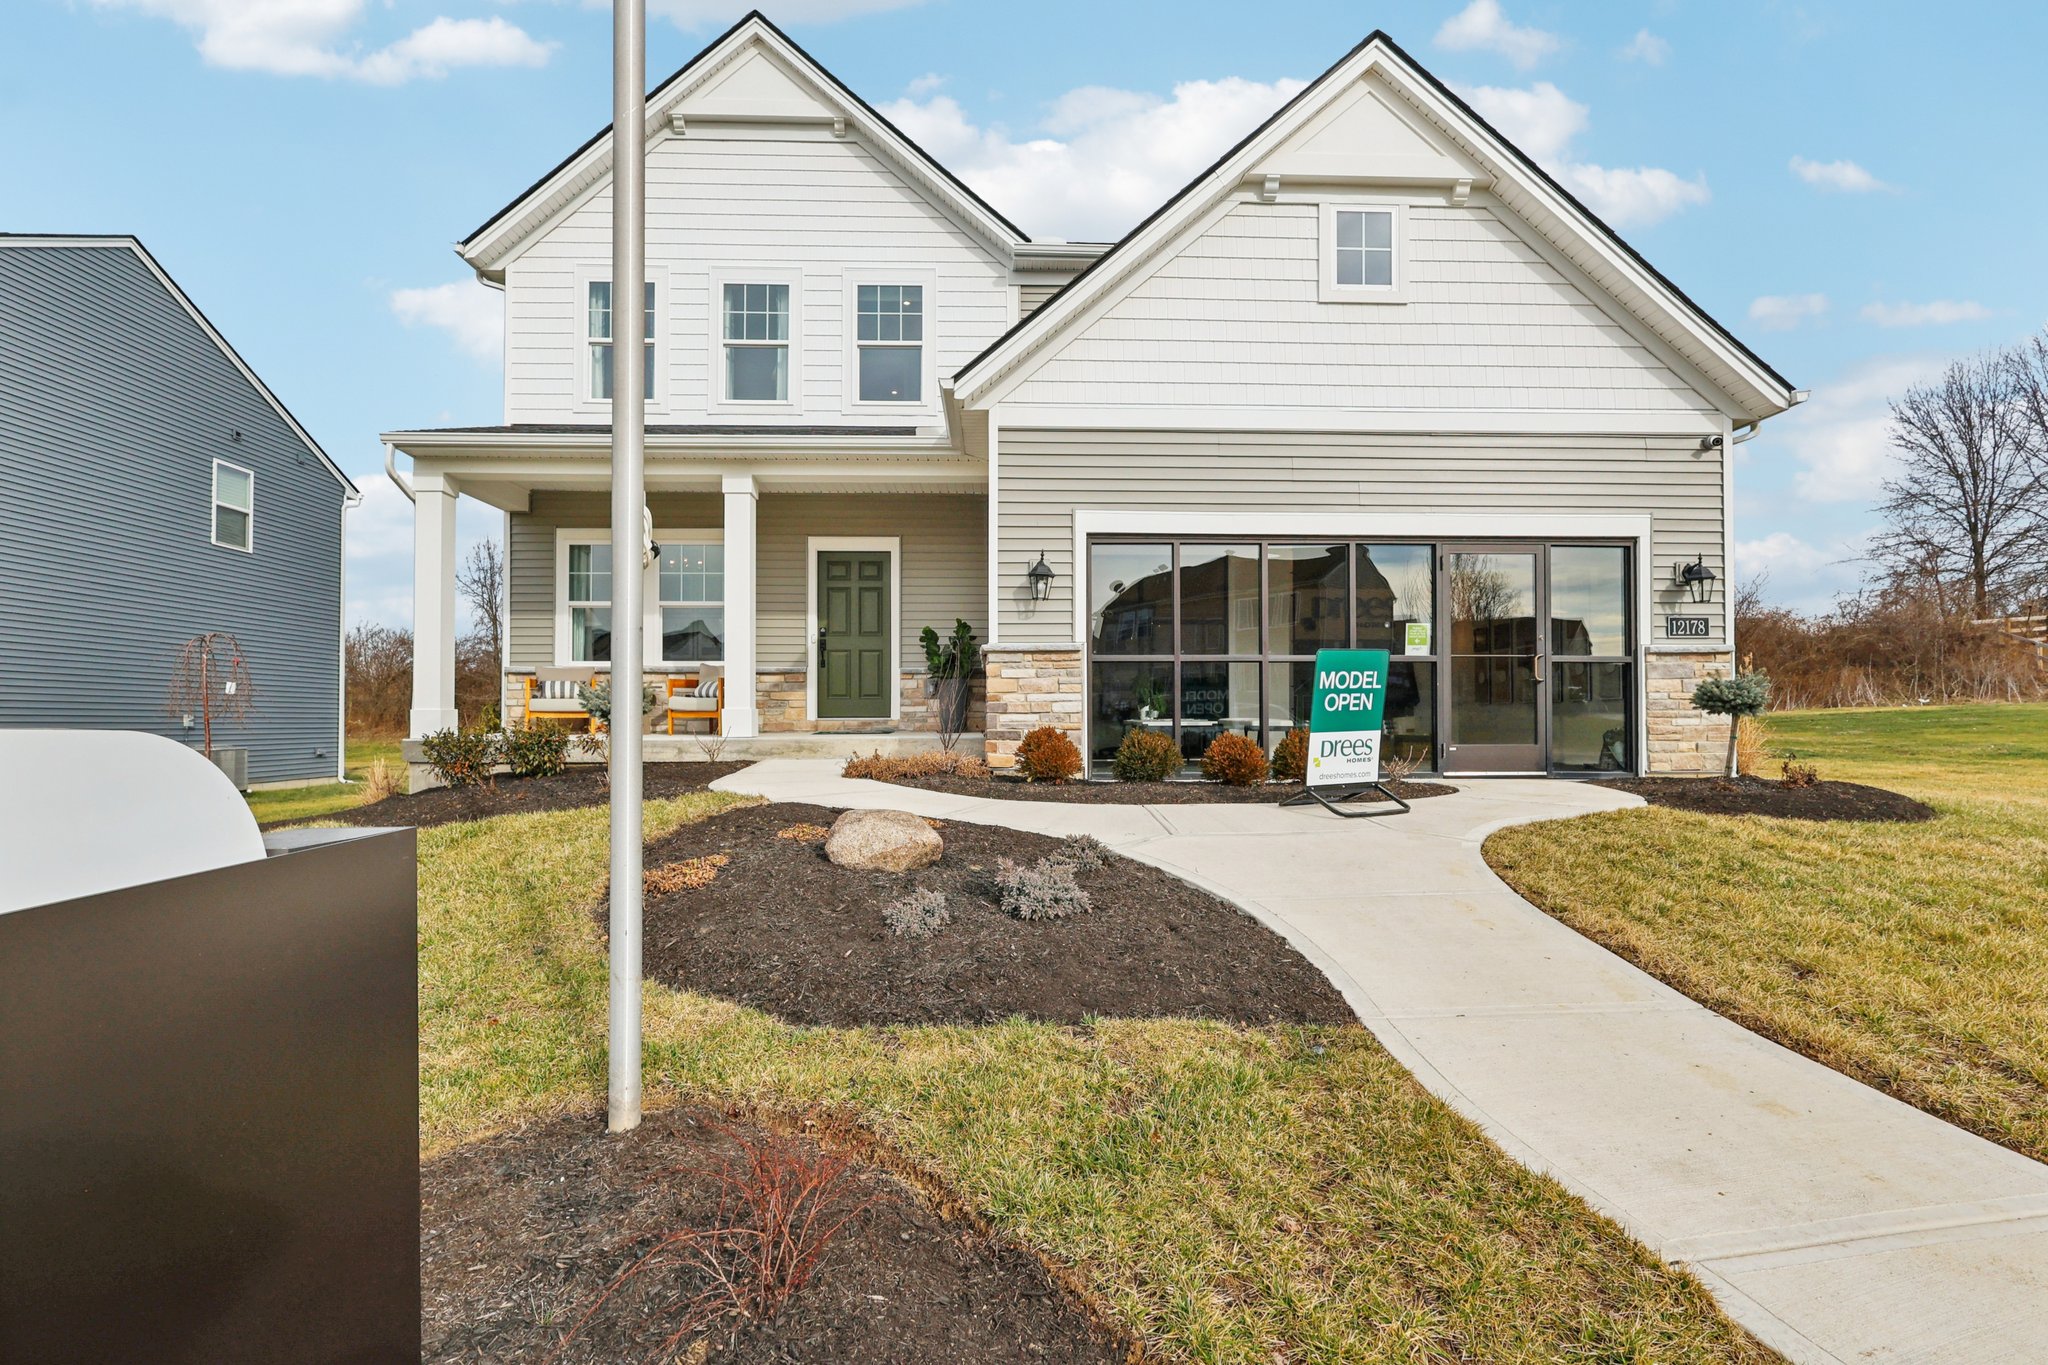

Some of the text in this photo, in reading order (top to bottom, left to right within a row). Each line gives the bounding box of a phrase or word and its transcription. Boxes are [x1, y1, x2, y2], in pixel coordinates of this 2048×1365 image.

[1672, 620, 1705, 634] 12178
[1319, 670, 1382, 690] MODEL
[1324, 692, 1374, 712] OPEN
[1321, 738, 1373, 757] Drees
[1319, 771, 1371, 780] dreeshomes.com
